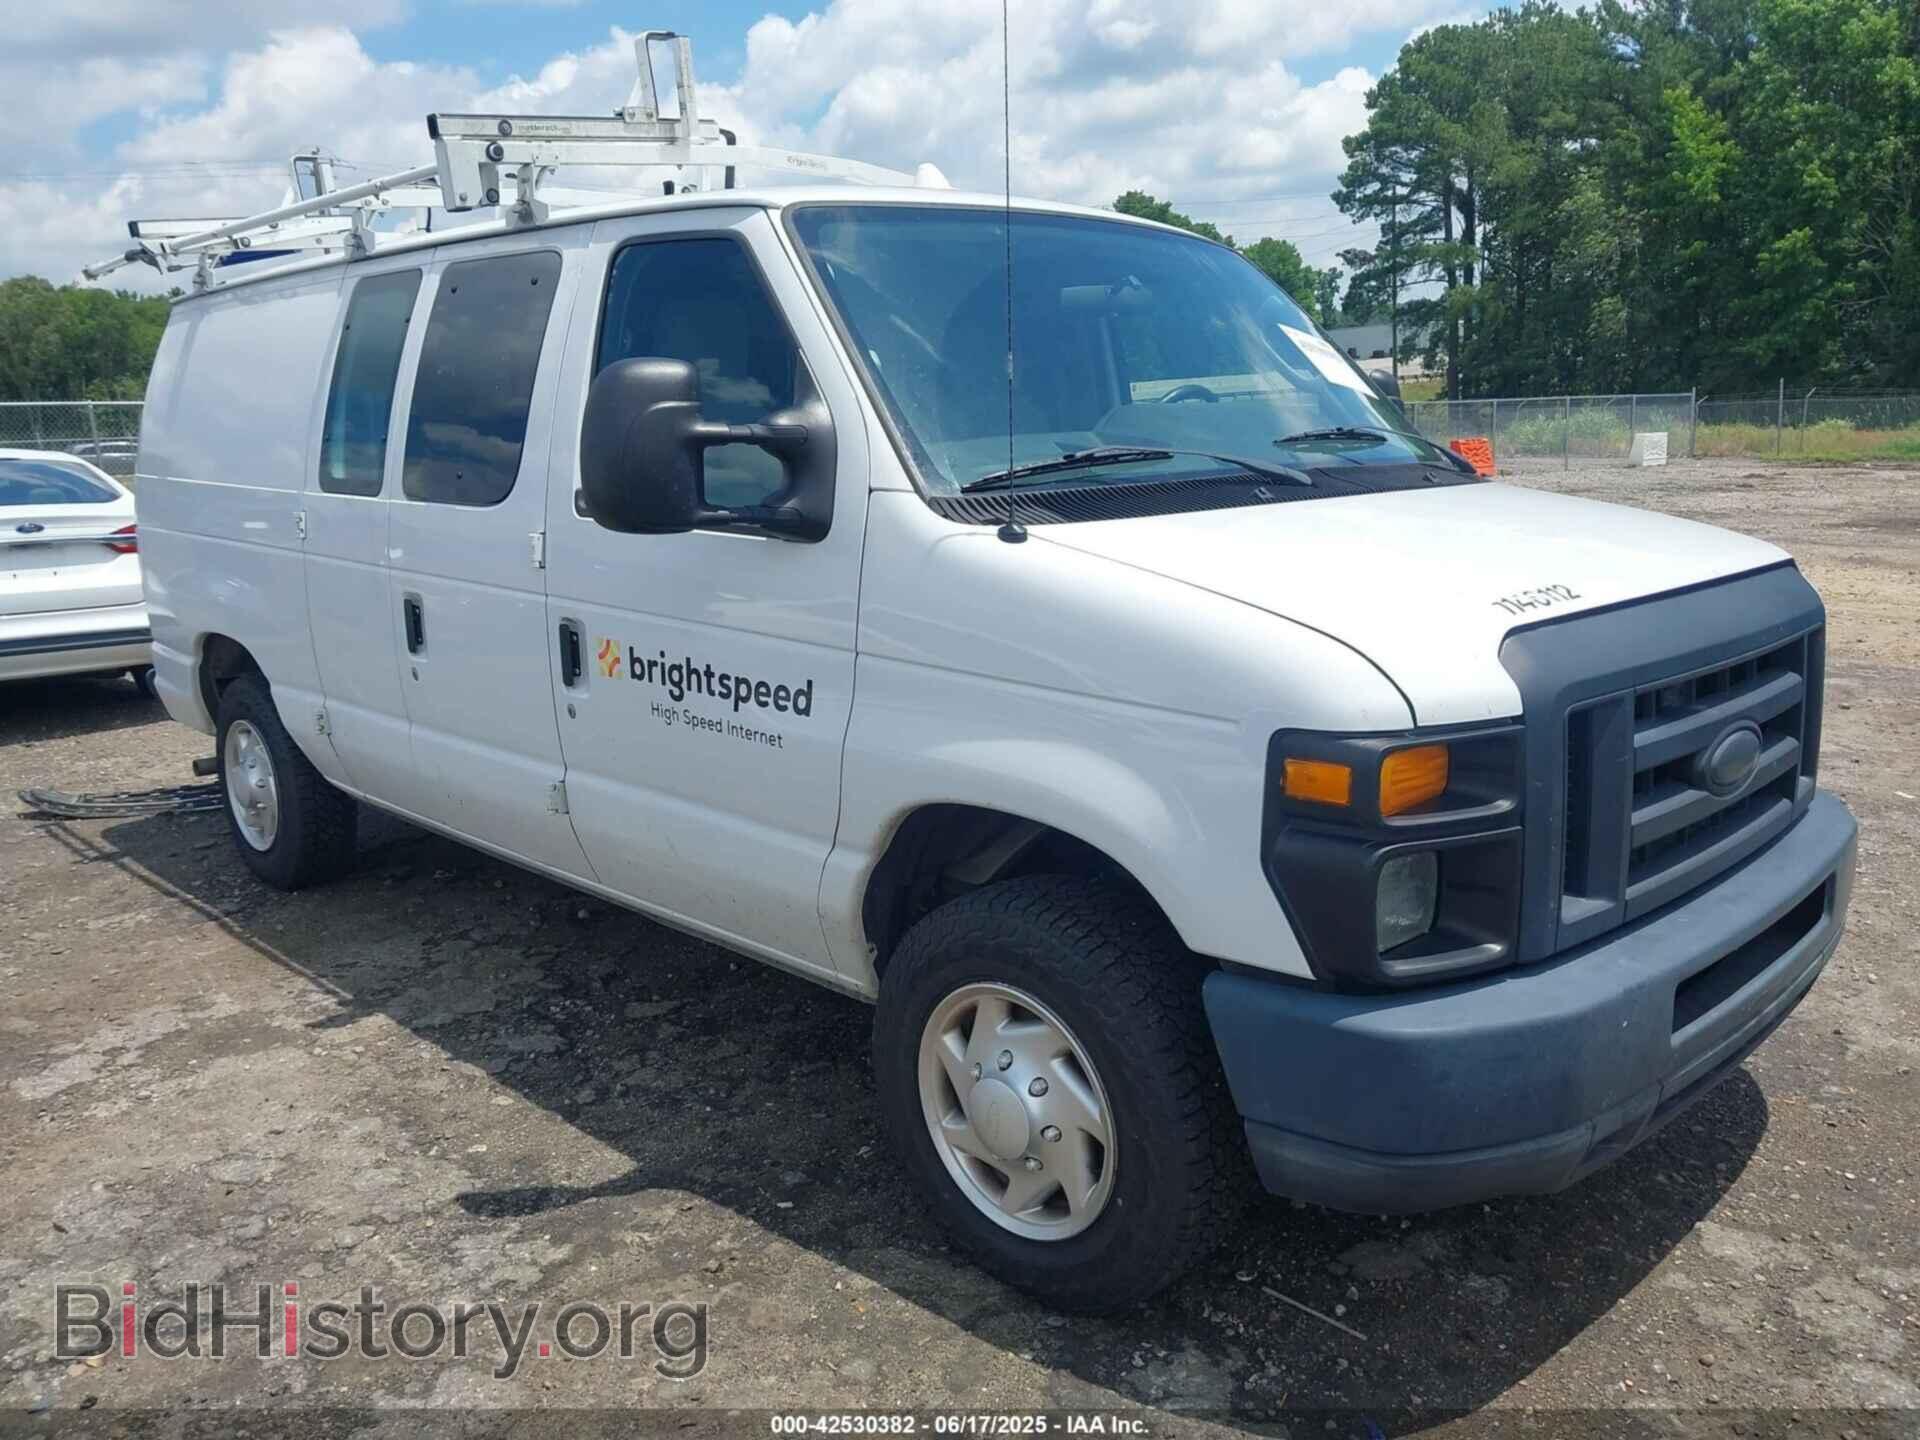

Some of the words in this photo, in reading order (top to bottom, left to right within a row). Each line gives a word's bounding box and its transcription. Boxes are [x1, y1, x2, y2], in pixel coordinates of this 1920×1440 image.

[628, 646, 814, 717] brightspeed
[651, 702, 680, 726] High
[682, 708, 723, 731] Speed
[727, 720, 783, 749] Internet
